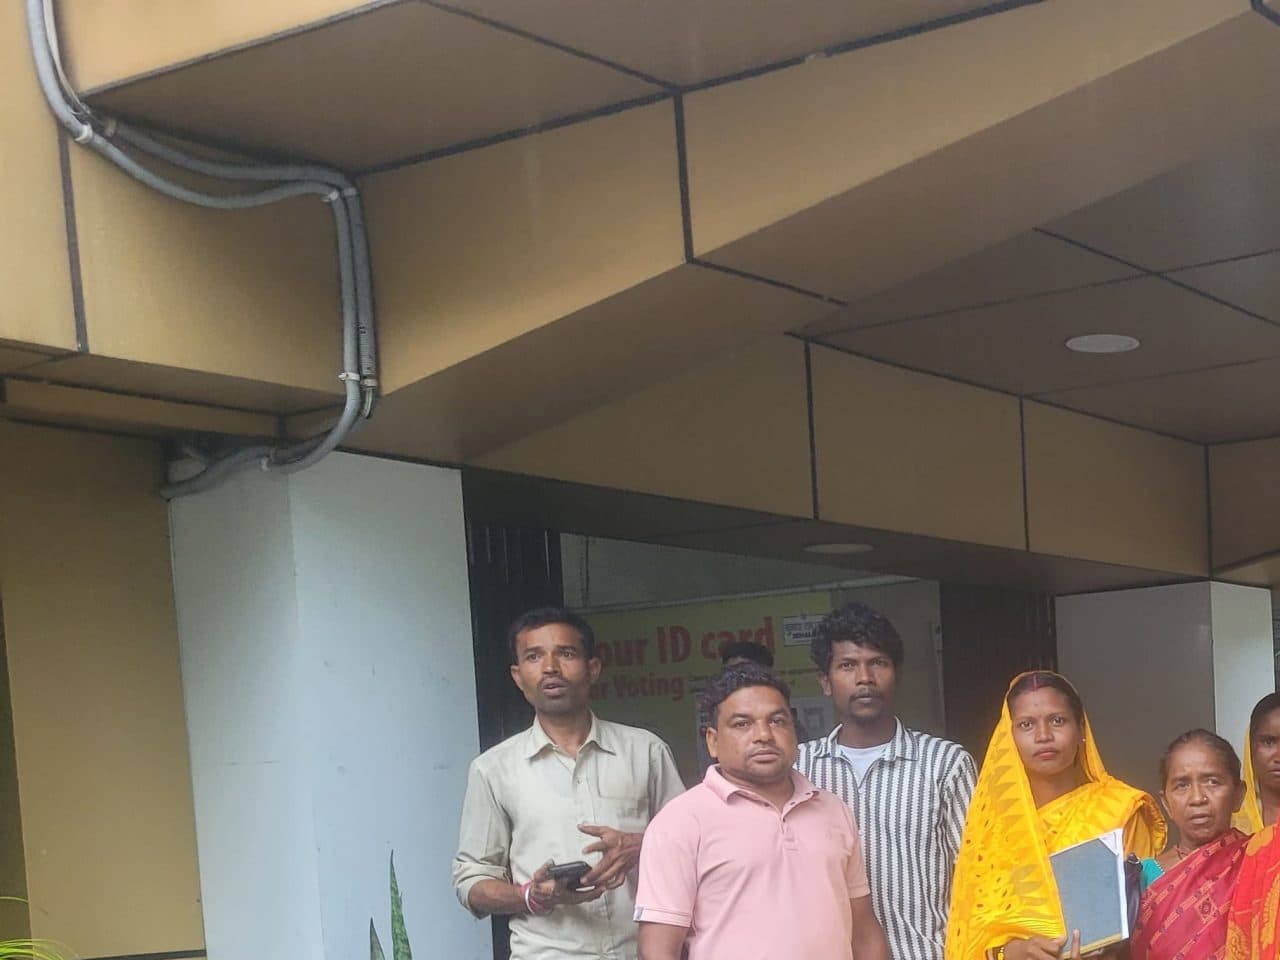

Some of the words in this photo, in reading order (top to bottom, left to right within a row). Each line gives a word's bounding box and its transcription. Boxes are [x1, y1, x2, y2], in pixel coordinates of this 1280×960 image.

[594, 639, 648, 670] our
[656, 625, 691, 664] ID
[614, 672, 685, 702] Voting
